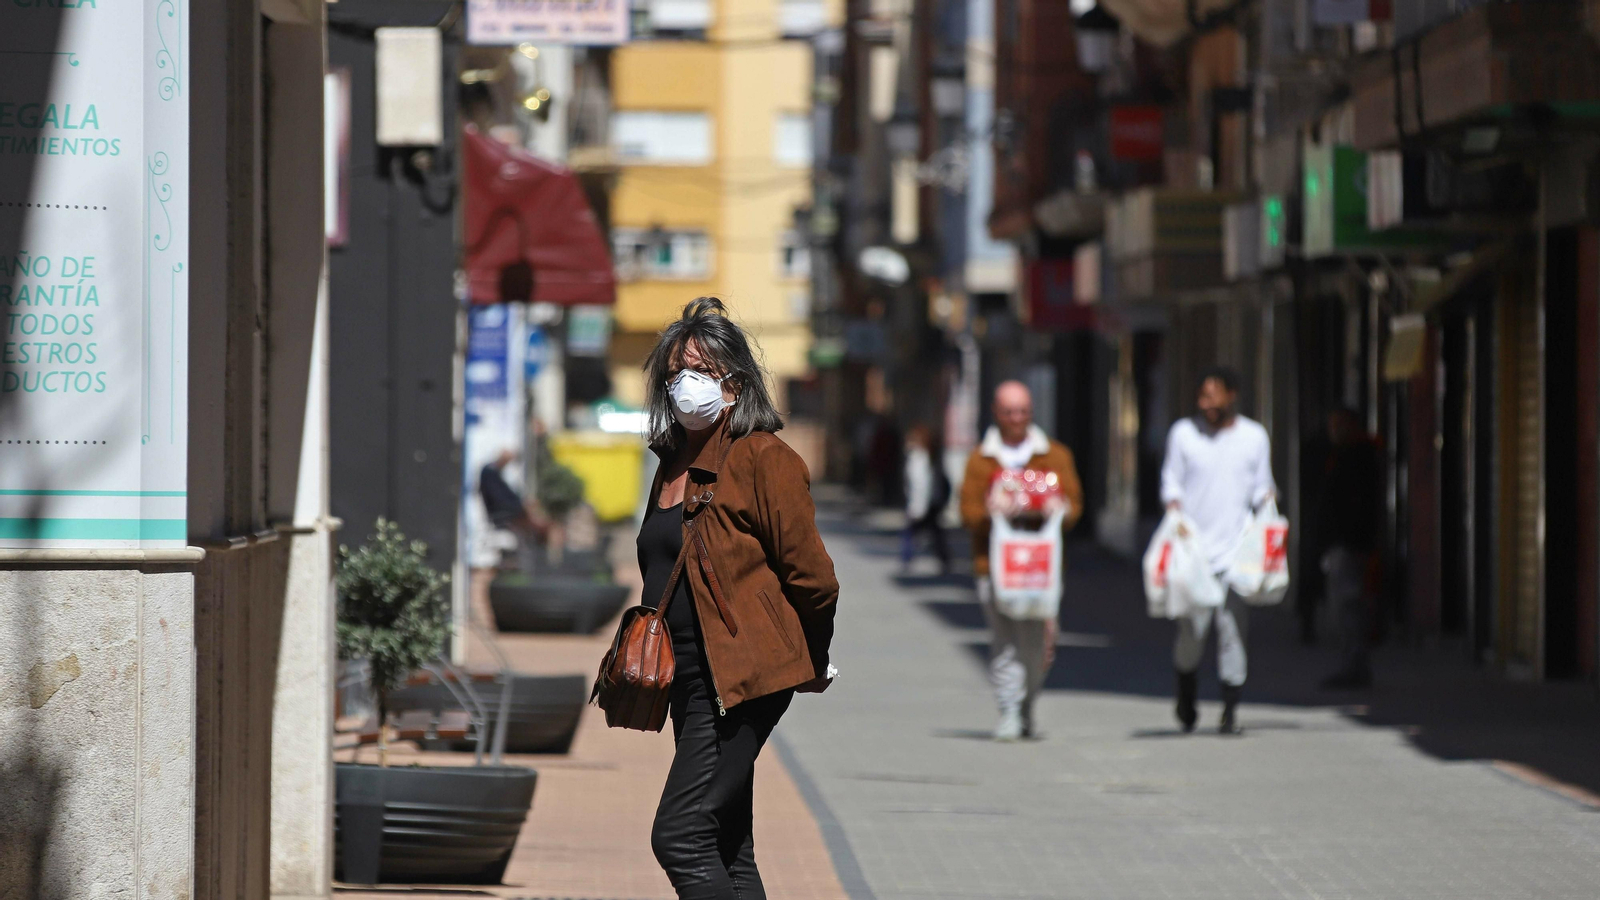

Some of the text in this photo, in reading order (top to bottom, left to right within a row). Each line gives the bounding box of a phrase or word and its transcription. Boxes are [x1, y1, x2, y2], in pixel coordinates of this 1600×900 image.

[0, 102, 99, 130] EGALA
[0, 136, 121, 156] TIMIENTOS
[61, 256, 95, 278] DE
[6, 313, 94, 335] TODOS
[2, 342, 97, 364] ESTROS
[2, 371, 107, 393] DUCTOS
